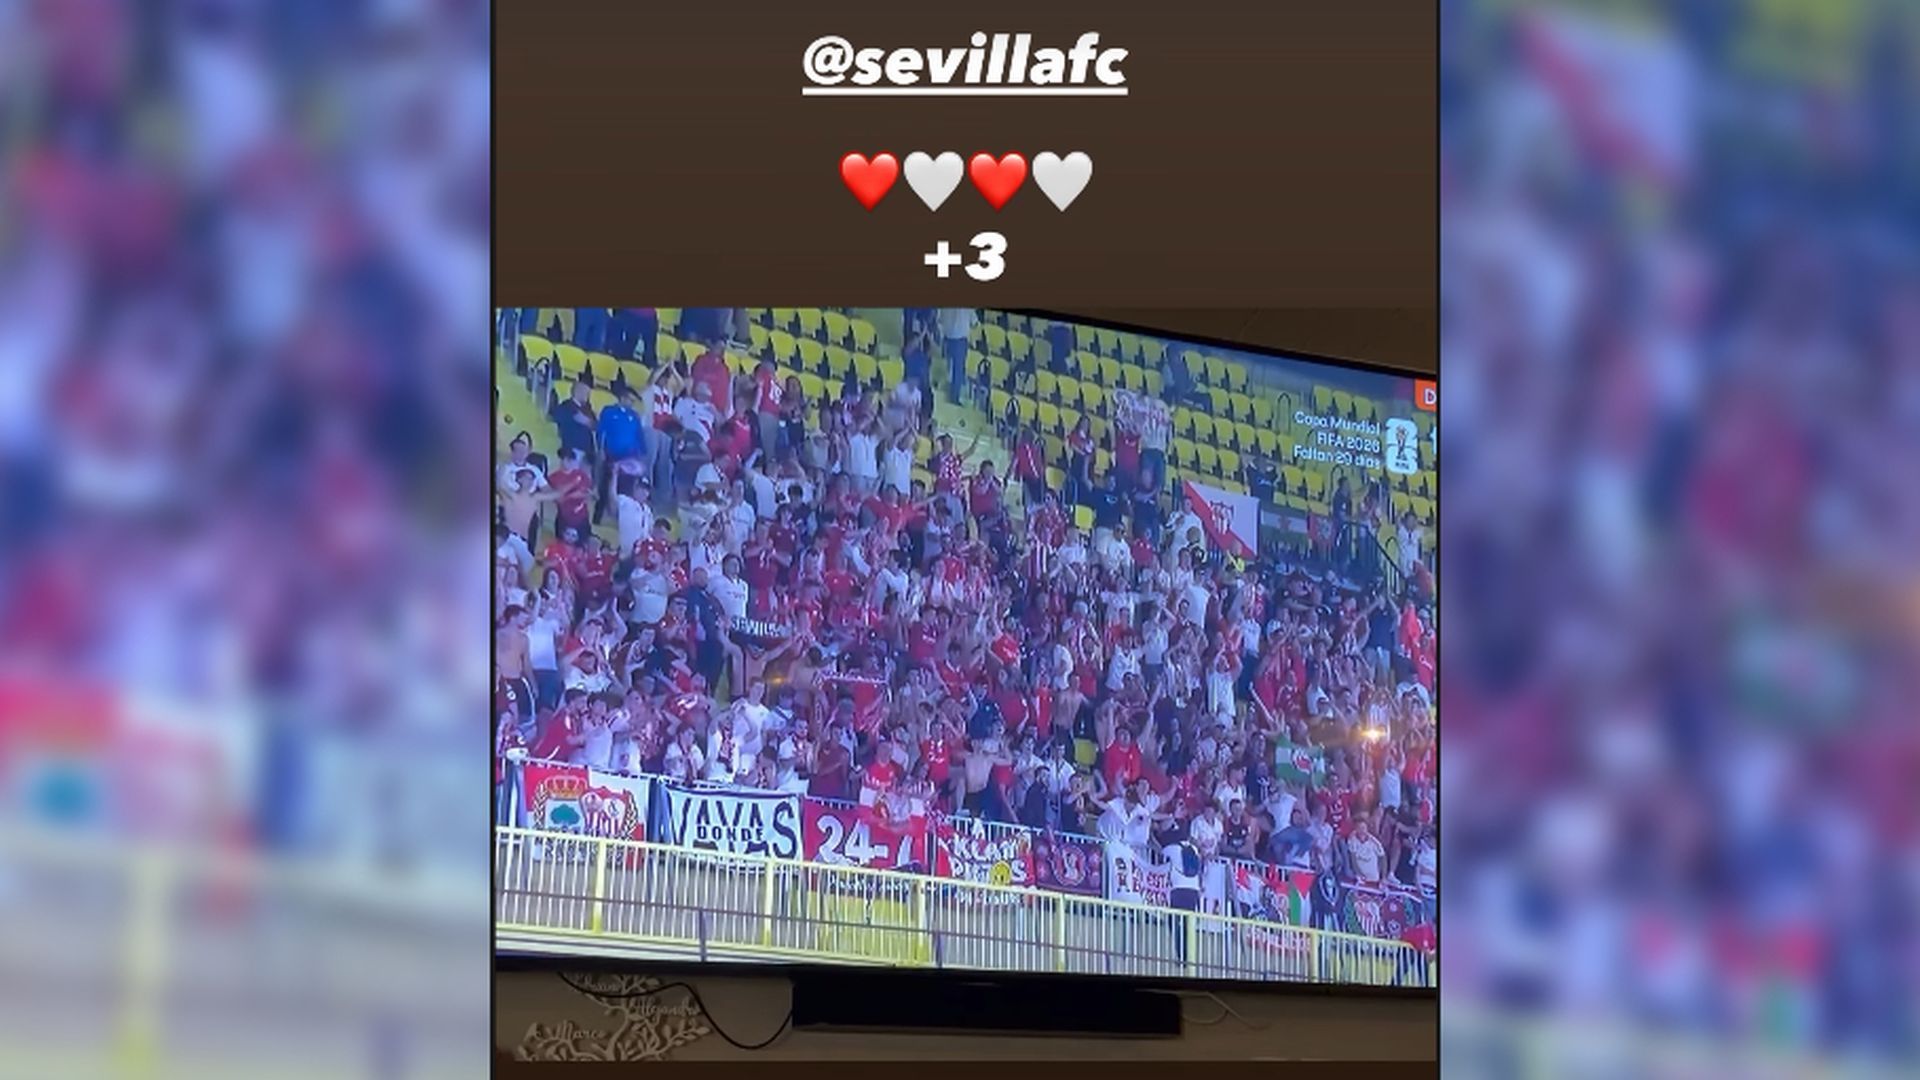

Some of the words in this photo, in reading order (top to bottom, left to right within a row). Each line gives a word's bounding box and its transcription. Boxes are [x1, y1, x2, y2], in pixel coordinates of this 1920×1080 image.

[1294, 411, 1329, 428] Copa
[1330, 416, 1380, 436] Mundial
[1317, 431, 1345, 448] FIFA
[697, 826, 764, 842] DONDE
